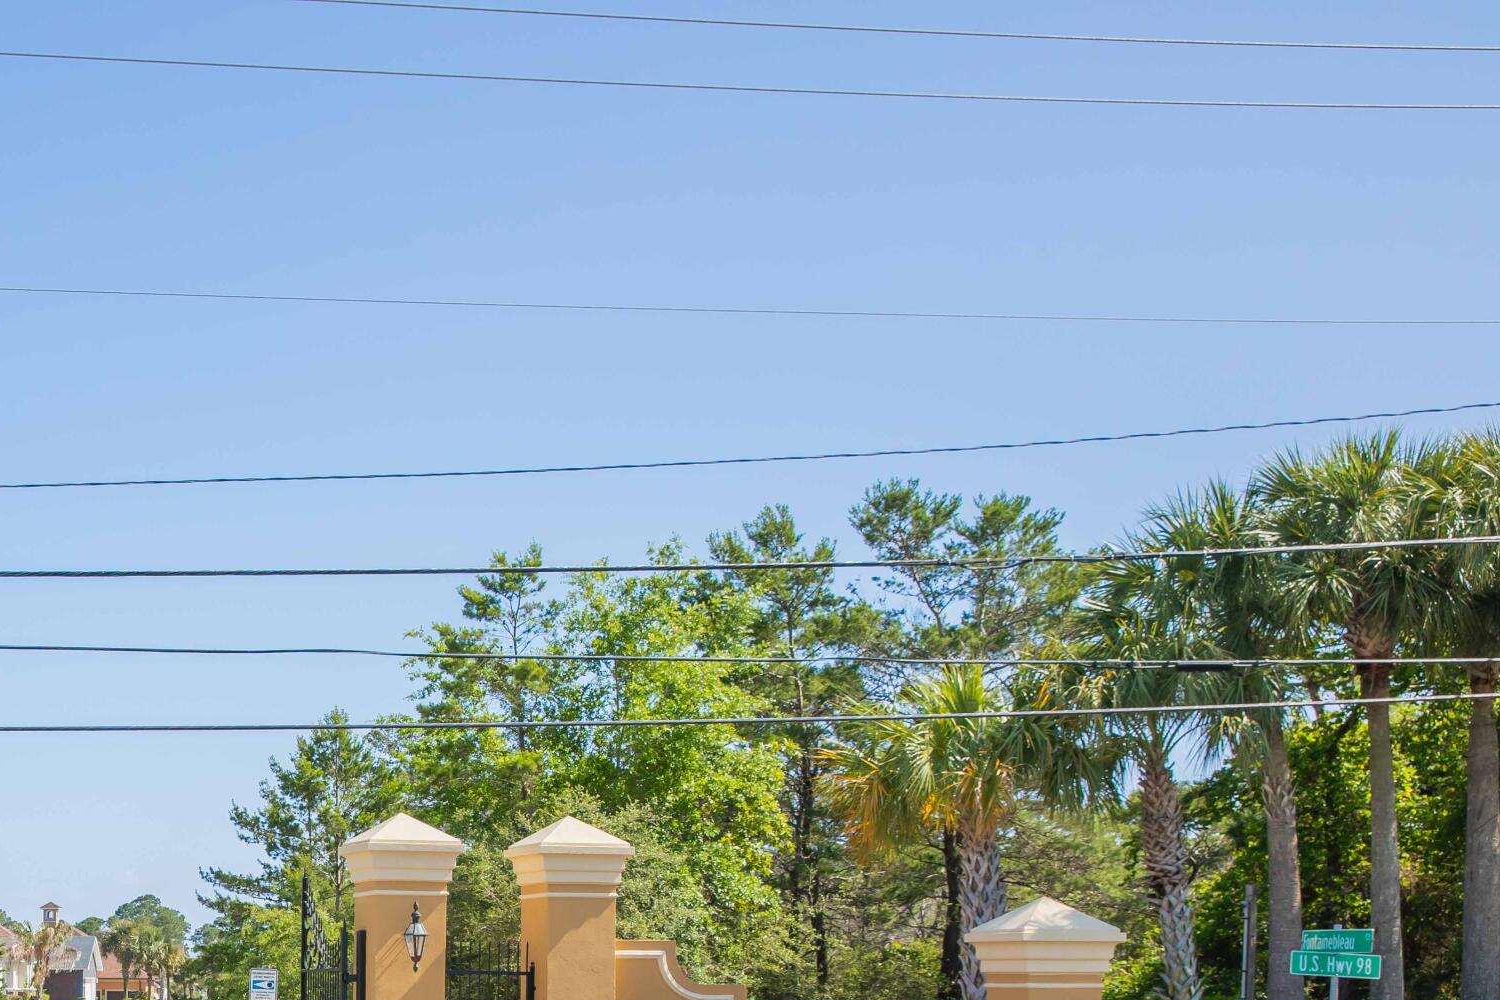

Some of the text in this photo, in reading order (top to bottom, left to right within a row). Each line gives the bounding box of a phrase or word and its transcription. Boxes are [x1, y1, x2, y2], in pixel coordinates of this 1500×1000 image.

[1303, 933, 1355, 950] Fontainebleau
[1299, 954, 1372, 975] U.S. Hwy 98
